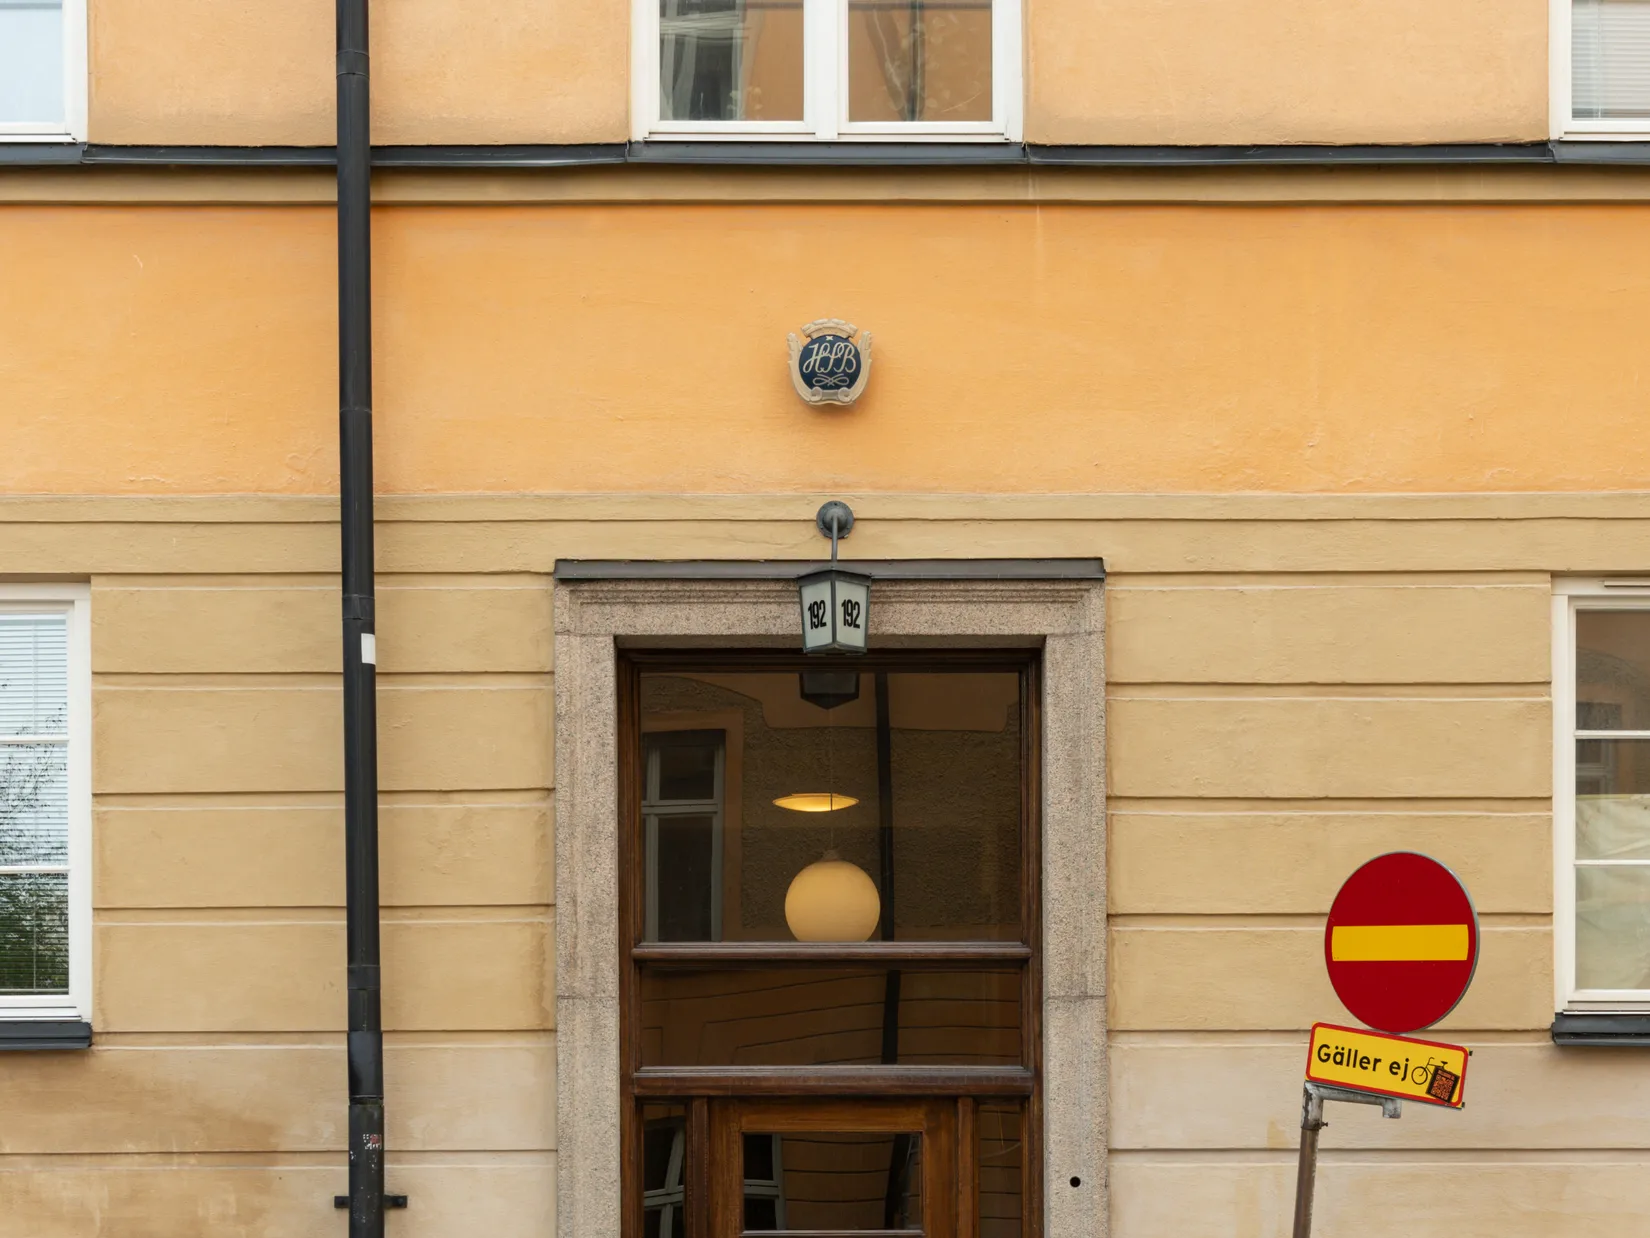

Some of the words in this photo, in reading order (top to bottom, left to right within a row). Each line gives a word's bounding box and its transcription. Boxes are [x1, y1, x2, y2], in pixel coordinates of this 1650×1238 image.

[808, 599, 827, 630] 192
[841, 598, 861, 629] 192
[1317, 1044, 1382, 1072] Gäller
[1389, 1058, 1409, 1081] ej
